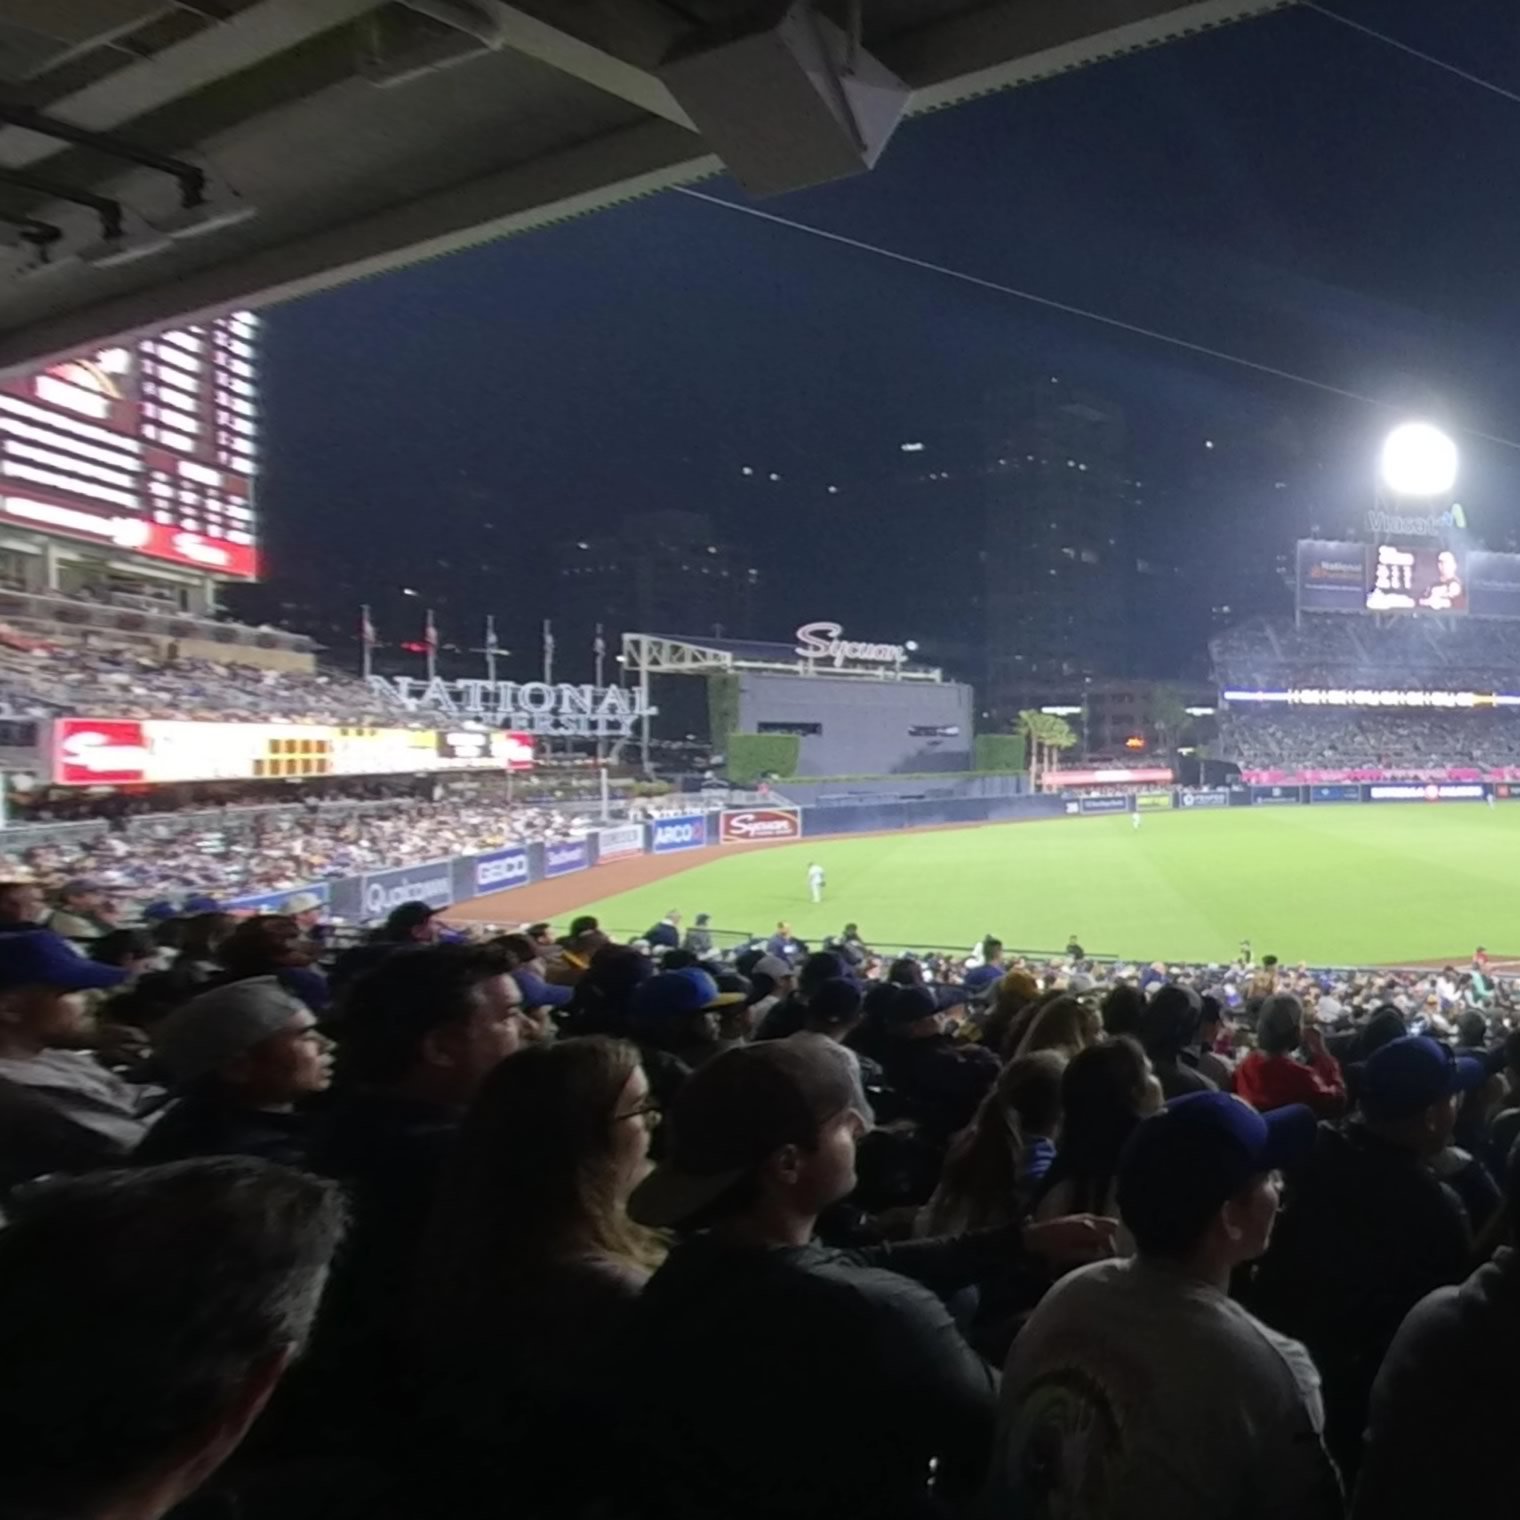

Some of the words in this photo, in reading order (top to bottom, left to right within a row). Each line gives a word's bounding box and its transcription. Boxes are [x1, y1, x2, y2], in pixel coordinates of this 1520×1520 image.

[795, 621, 908, 667] Sycuan
[366, 675, 658, 715] NATIONAL
[656, 824, 692, 844] ARCO
[729, 814, 790, 837] Sycuan
[478, 854, 527, 884] GEICO
[367, 877, 450, 911] Qualcomm
